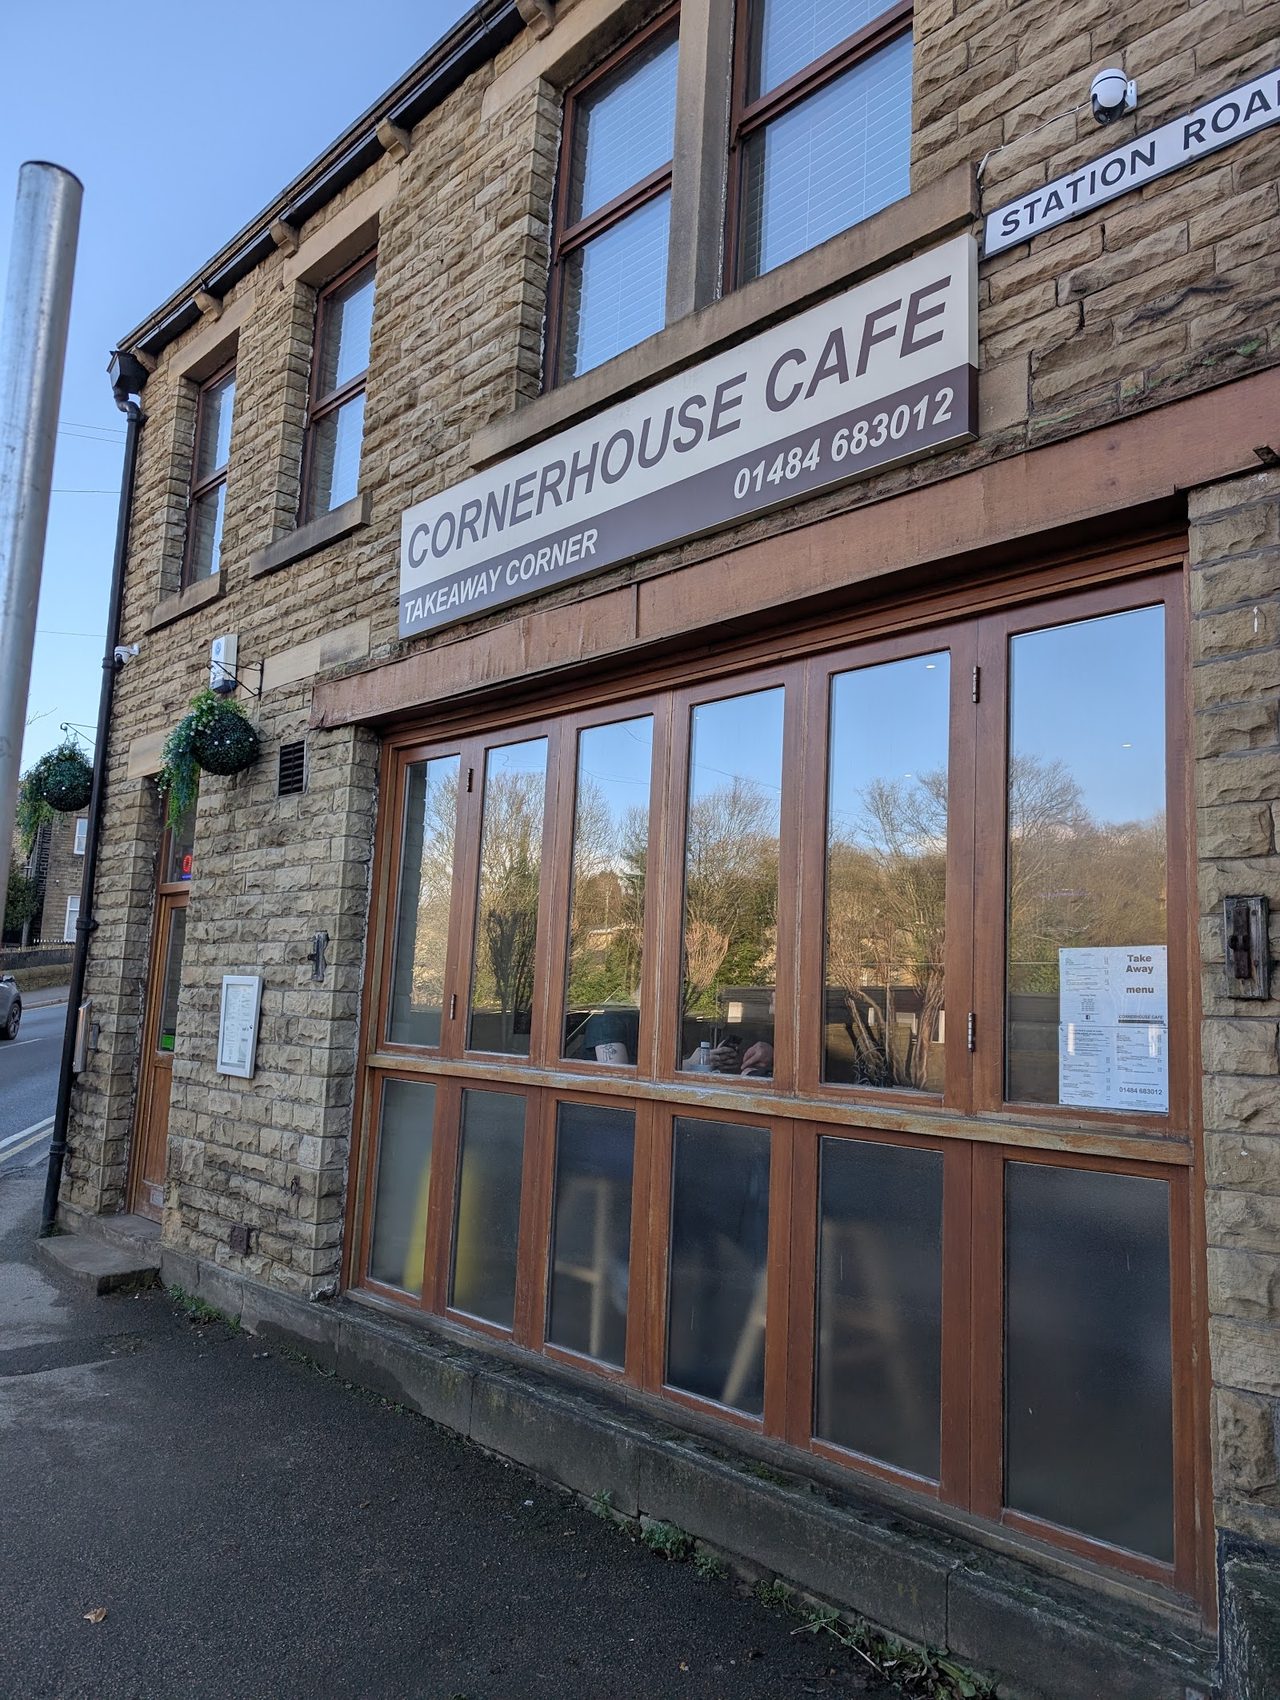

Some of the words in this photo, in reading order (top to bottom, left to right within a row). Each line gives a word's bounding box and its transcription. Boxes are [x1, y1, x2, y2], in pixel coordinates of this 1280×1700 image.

[1000, 140, 1156, 237] STATION
[1183, 80, 1280, 150] ROA
[408, 371, 747, 569] CORNERHOUSE
[765, 275, 952, 412] CAFE
[733, 438, 821, 499] 01484
[831, 387, 954, 462] 683012
[404, 565, 502, 624] TAKEAWAY
[505, 528, 599, 586] CORNER
[1126, 965, 1154, 974] Away
[1127, 954, 1152, 962] Take
